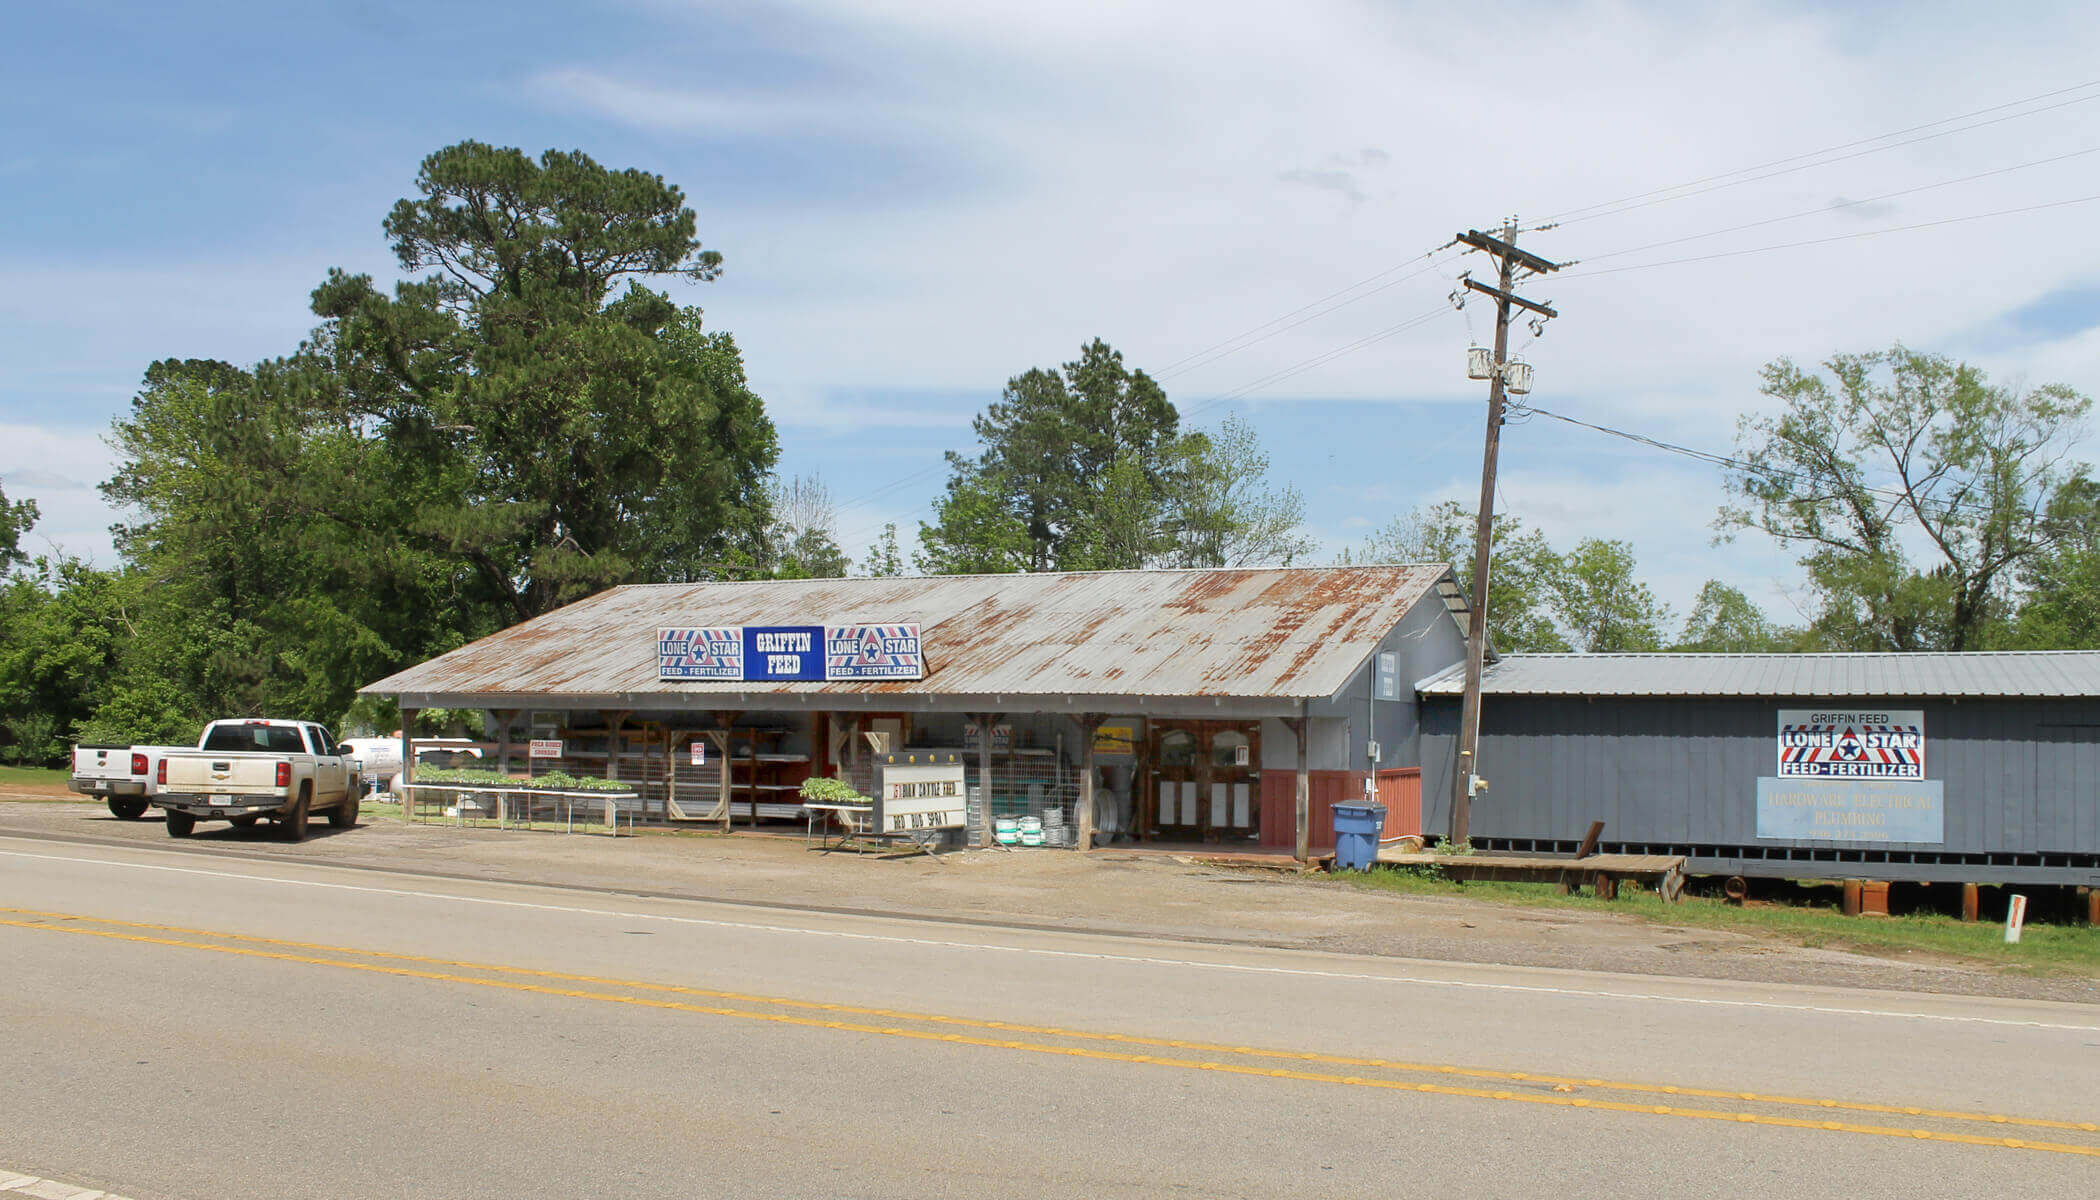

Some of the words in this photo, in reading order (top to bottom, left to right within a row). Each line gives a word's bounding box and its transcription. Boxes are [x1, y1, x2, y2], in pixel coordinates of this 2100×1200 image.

[661, 641, 688, 656] LONE
[710, 641, 739, 656] STAR
[756, 632, 811, 652] GRIFFIN
[829, 640, 858, 655] LONE
[885, 638, 916, 654] STAR
[662, 667, 683, 675] FEED
[689, 667, 739, 676] FERTILIZER
[767, 654, 801, 674] FEED
[830, 667, 854, 676] FEED
[861, 666, 917, 675] FERTILIZER
[1811, 713, 1855, 724] GRIFFIN
[1859, 713, 1888, 724] FEED
[1784, 733, 1832, 747] LONE
[1868, 733, 1917, 748] STAR
[1769, 791, 1844, 808] HARDWARE
[1854, 793, 1933, 809] ELECTRICAL
[1815, 811, 1885, 825] PLUMBING
